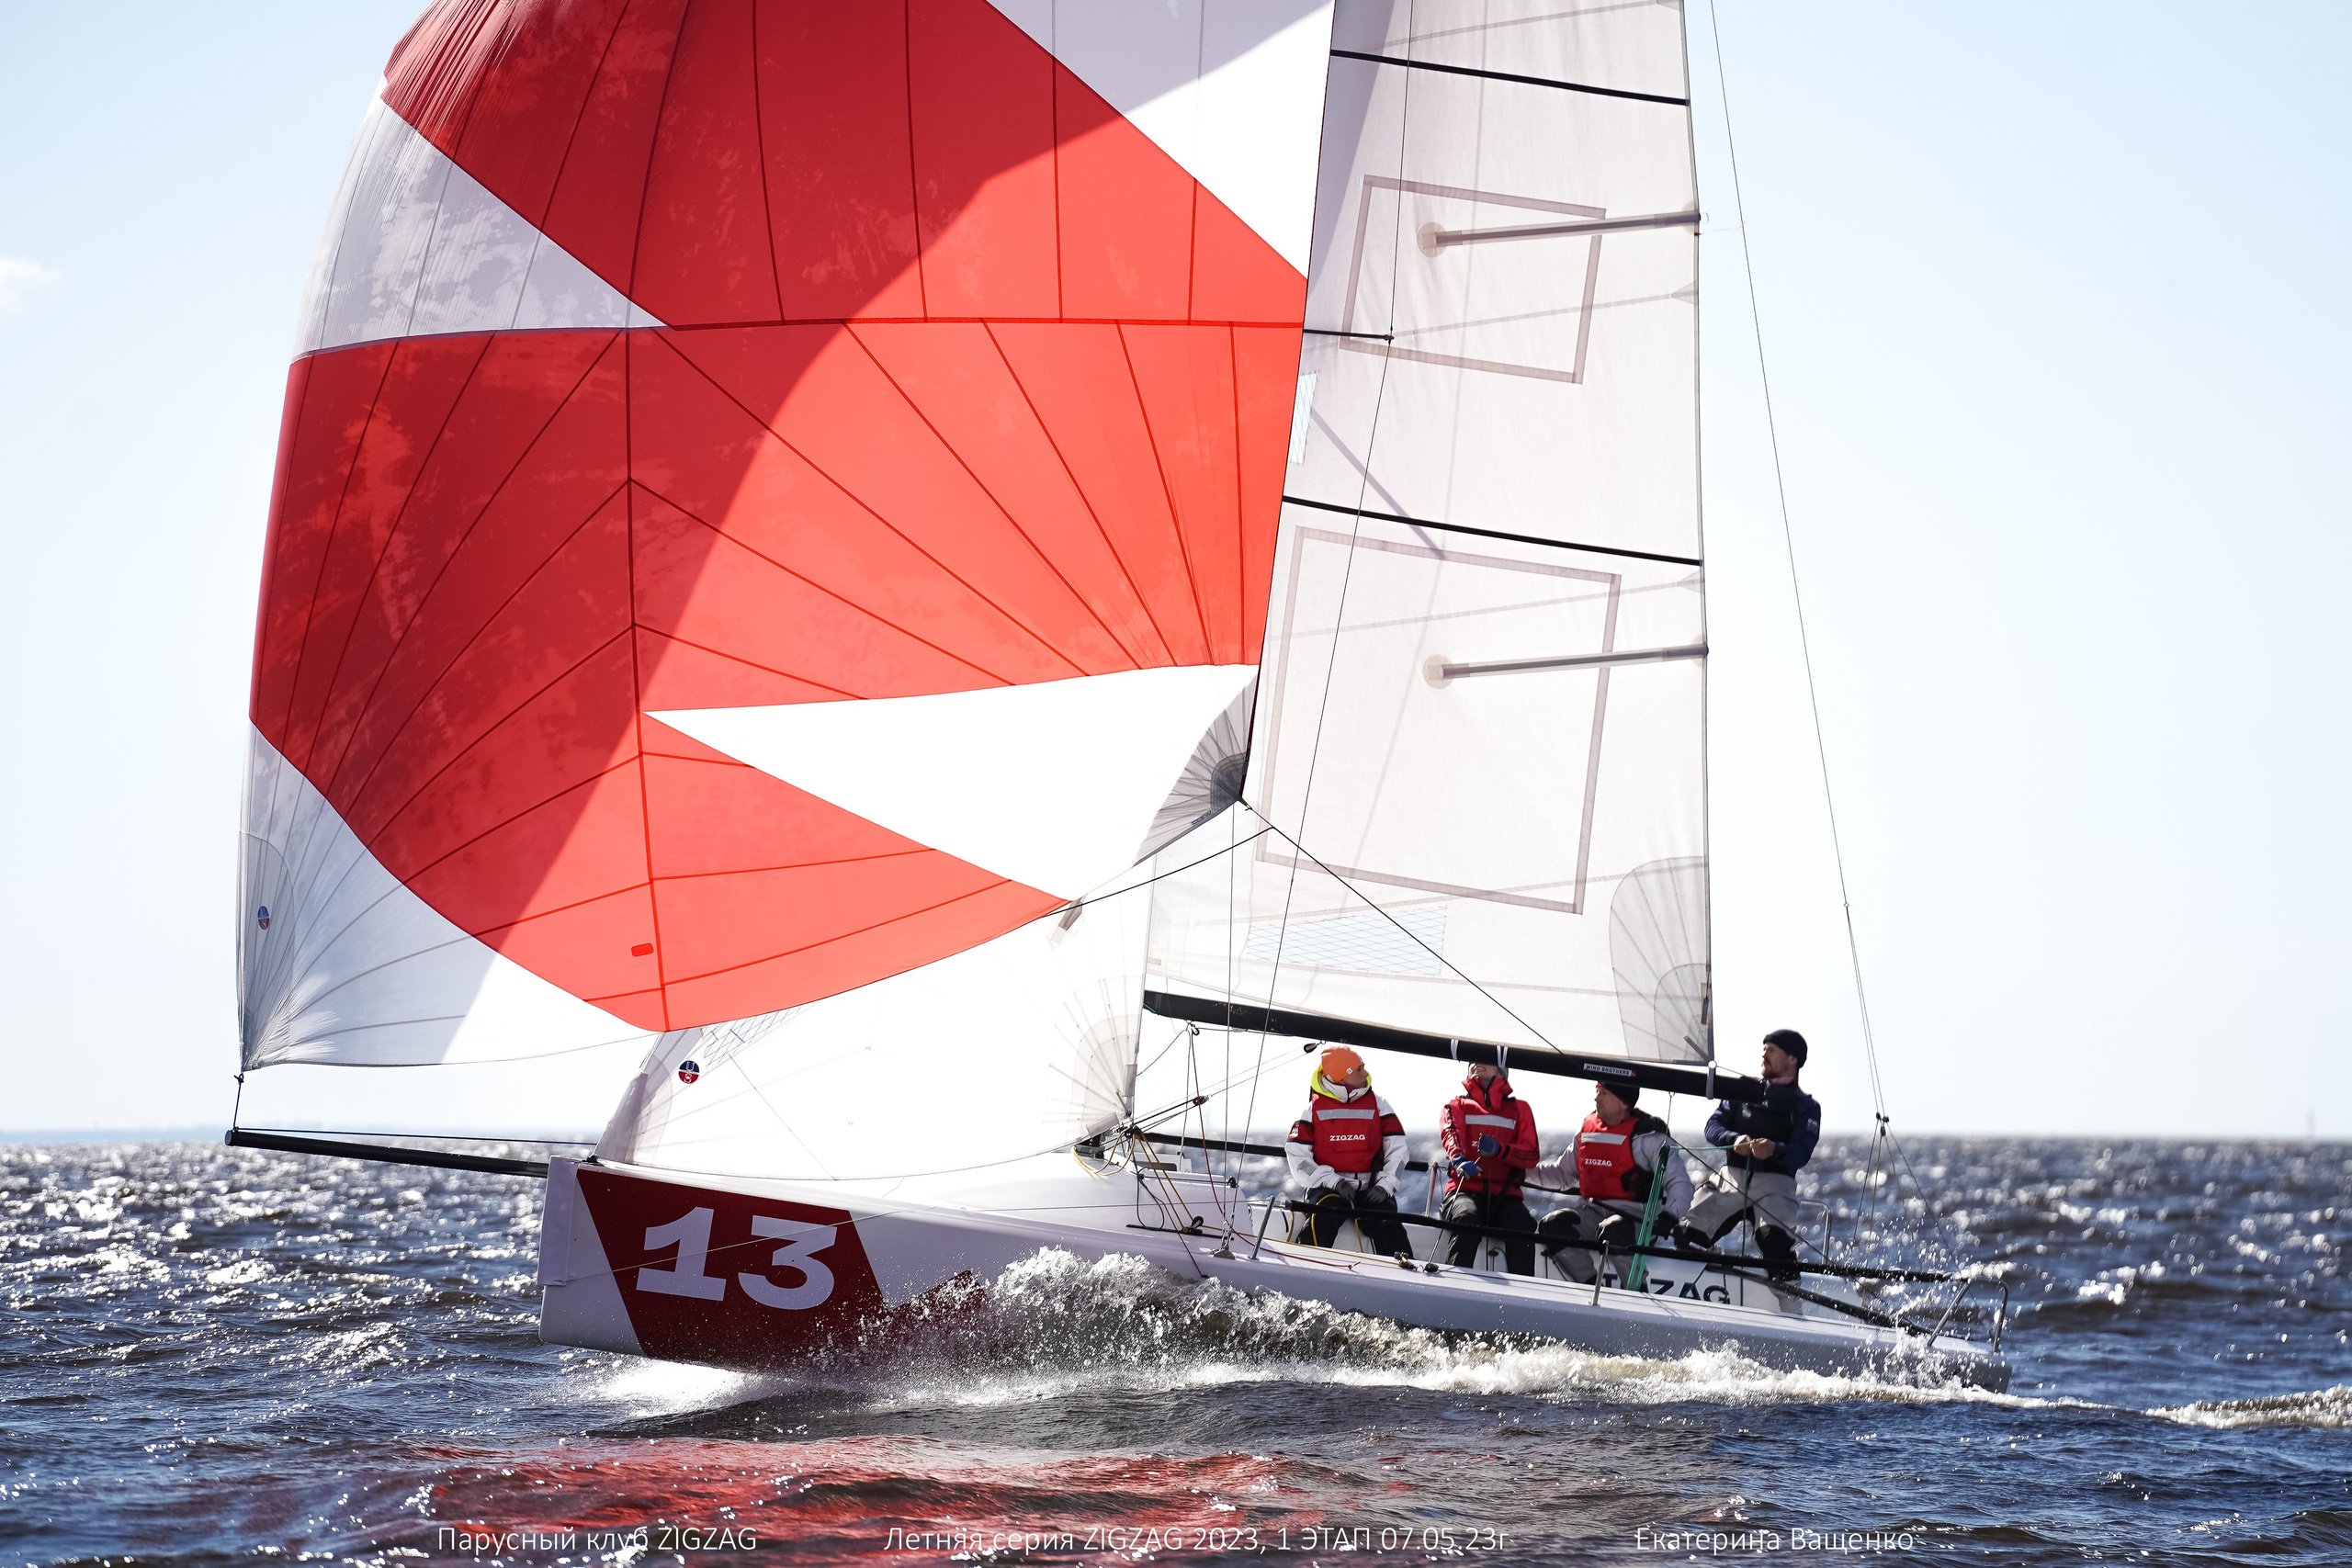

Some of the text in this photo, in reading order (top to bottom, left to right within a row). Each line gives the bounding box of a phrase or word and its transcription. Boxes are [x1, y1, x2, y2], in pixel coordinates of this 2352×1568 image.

[1601, 1066, 1630, 1076] BROTHERS
[1584, 1158, 1612, 1167] ZIGZAG
[636, 1206, 837, 1310] 13
